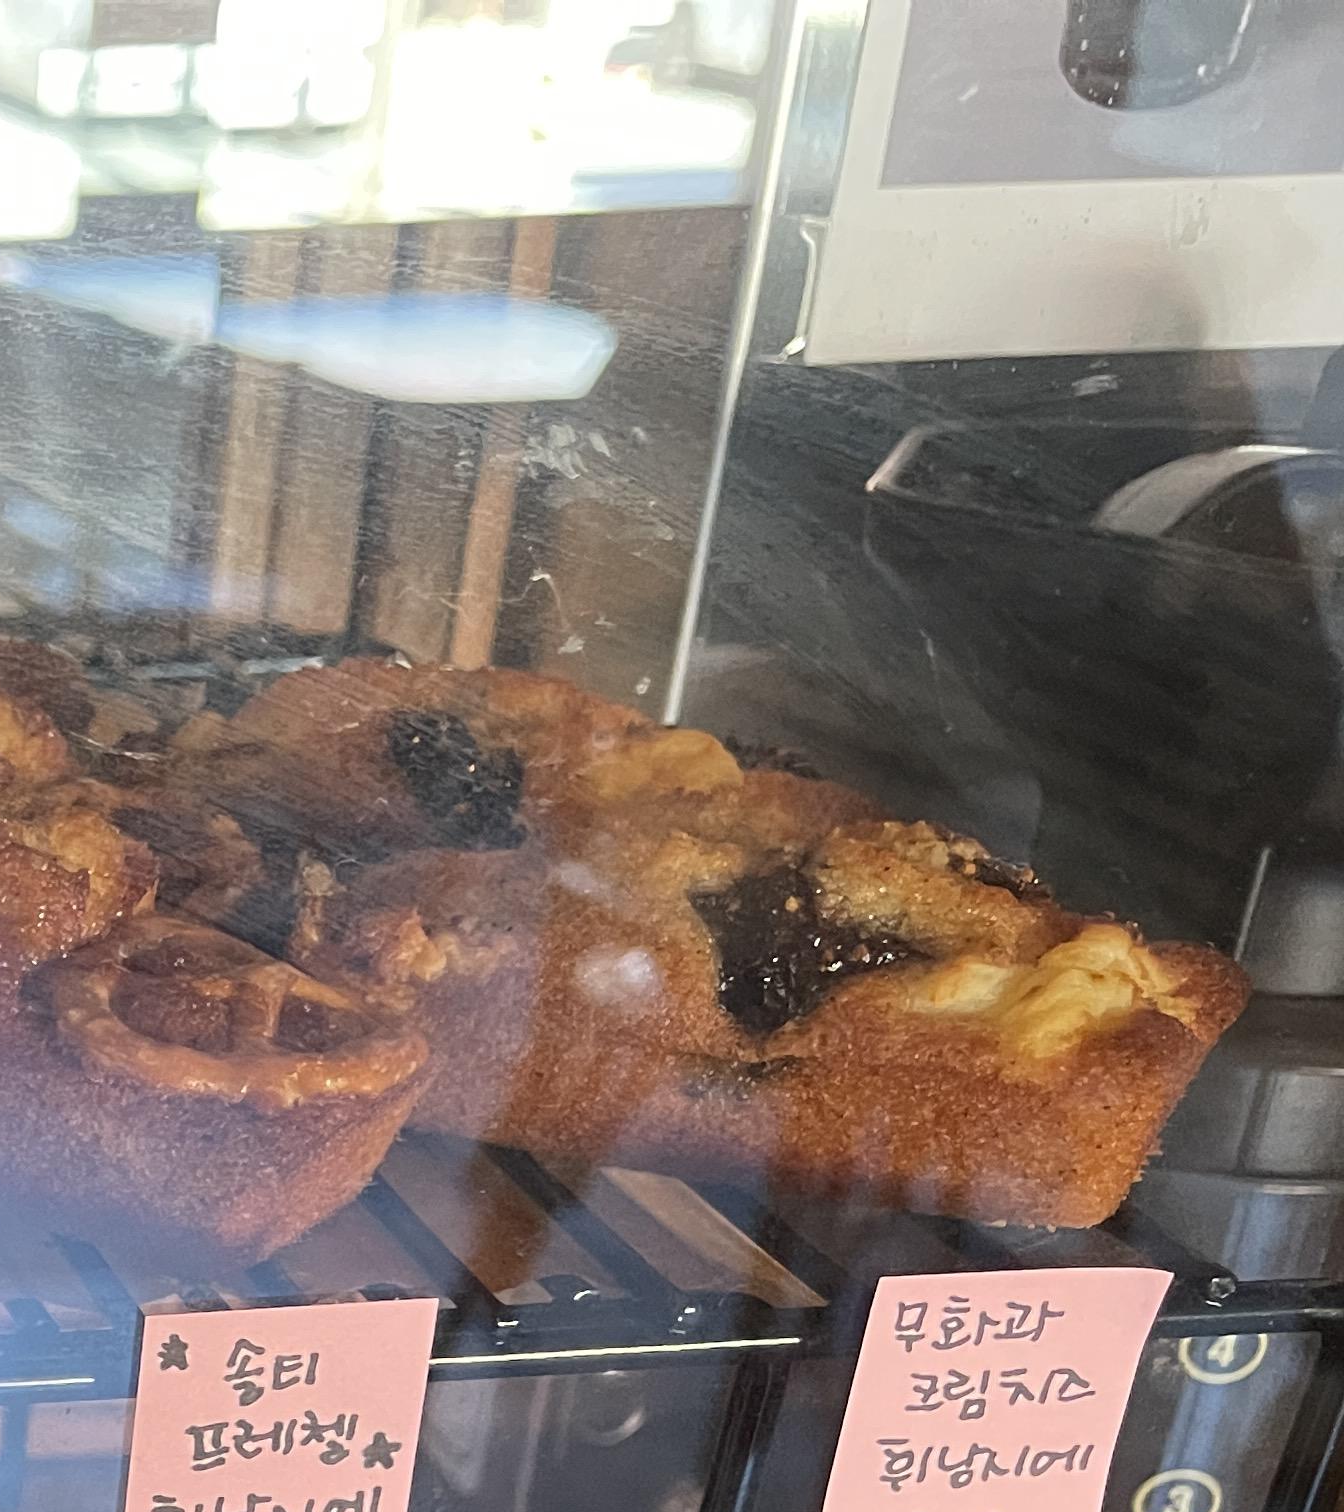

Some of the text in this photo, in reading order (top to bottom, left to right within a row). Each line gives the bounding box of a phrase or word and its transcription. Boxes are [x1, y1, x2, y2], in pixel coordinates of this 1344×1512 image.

[895, 1295, 1065, 1352] 무화과
[224, 1339, 319, 1407] 솔티
[904, 1368, 1096, 1420] 크림치즈
[876, 1439, 1094, 1492] 휘낭시에
